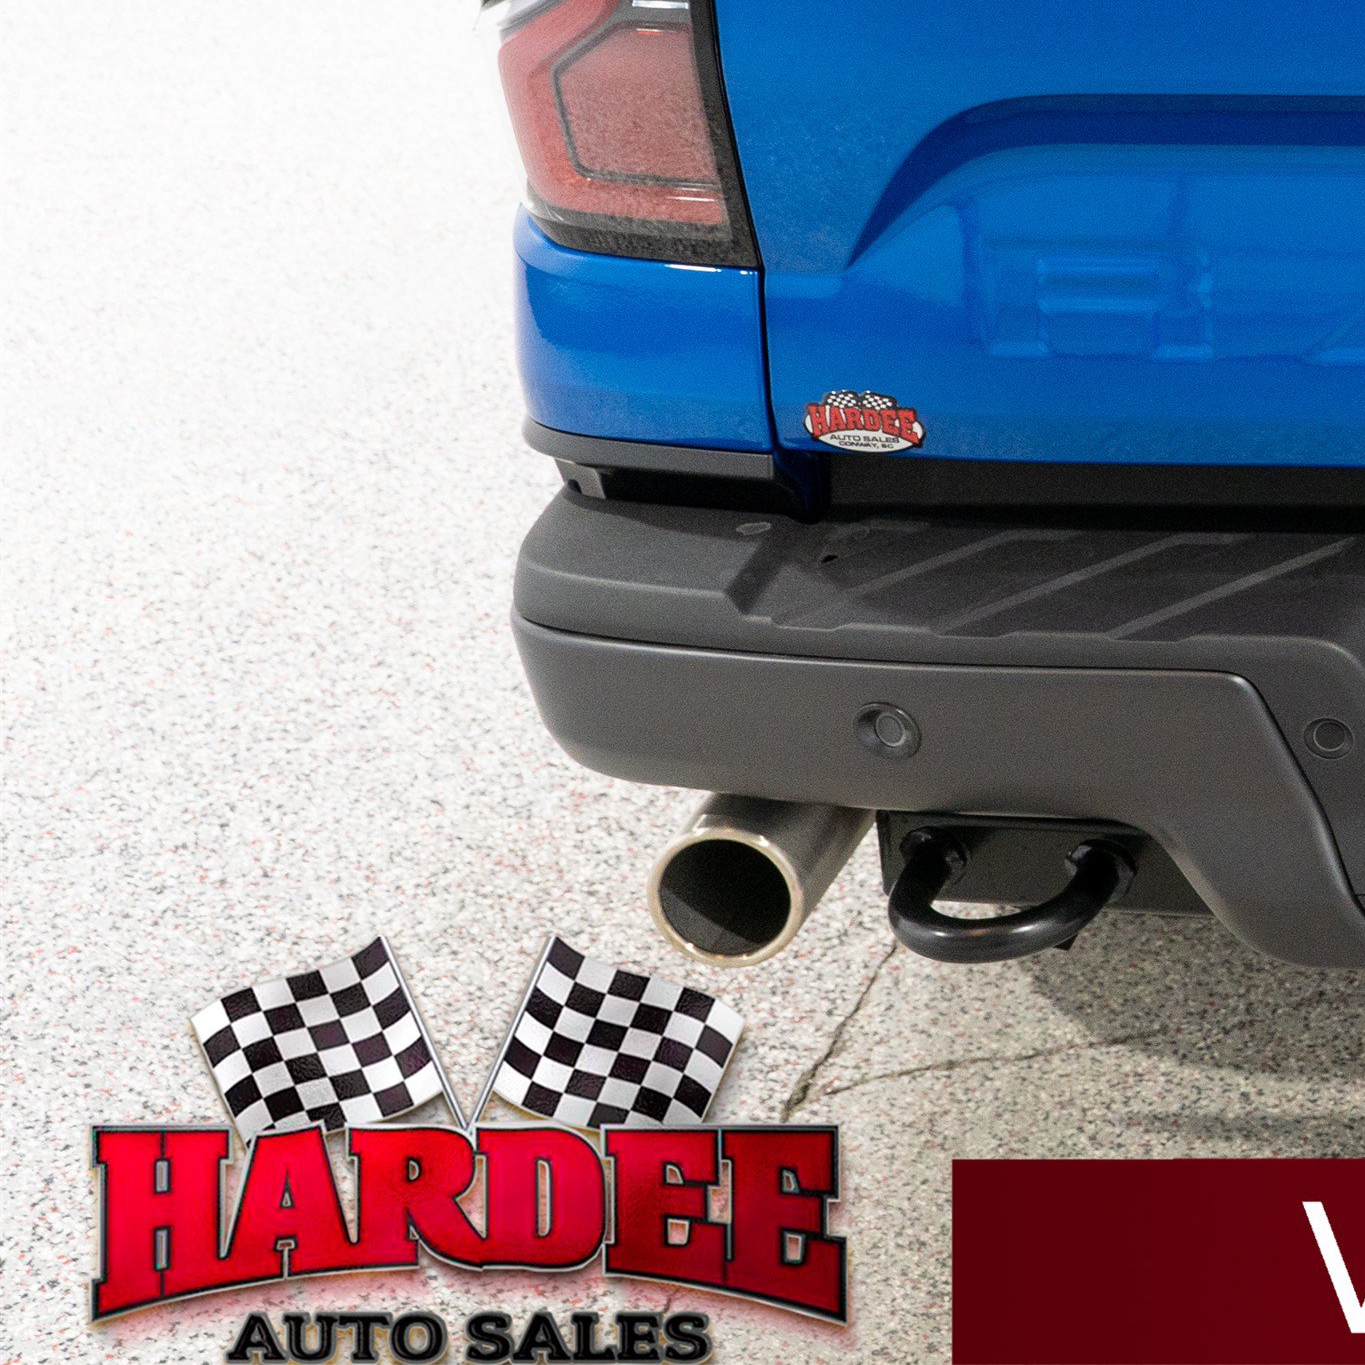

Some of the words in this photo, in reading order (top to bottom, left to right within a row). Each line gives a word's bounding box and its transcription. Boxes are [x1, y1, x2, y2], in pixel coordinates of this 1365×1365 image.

[807, 403, 921, 447] HARDEE
[830, 434, 861, 442] AUTO
[863, 436, 900, 444] SALES
